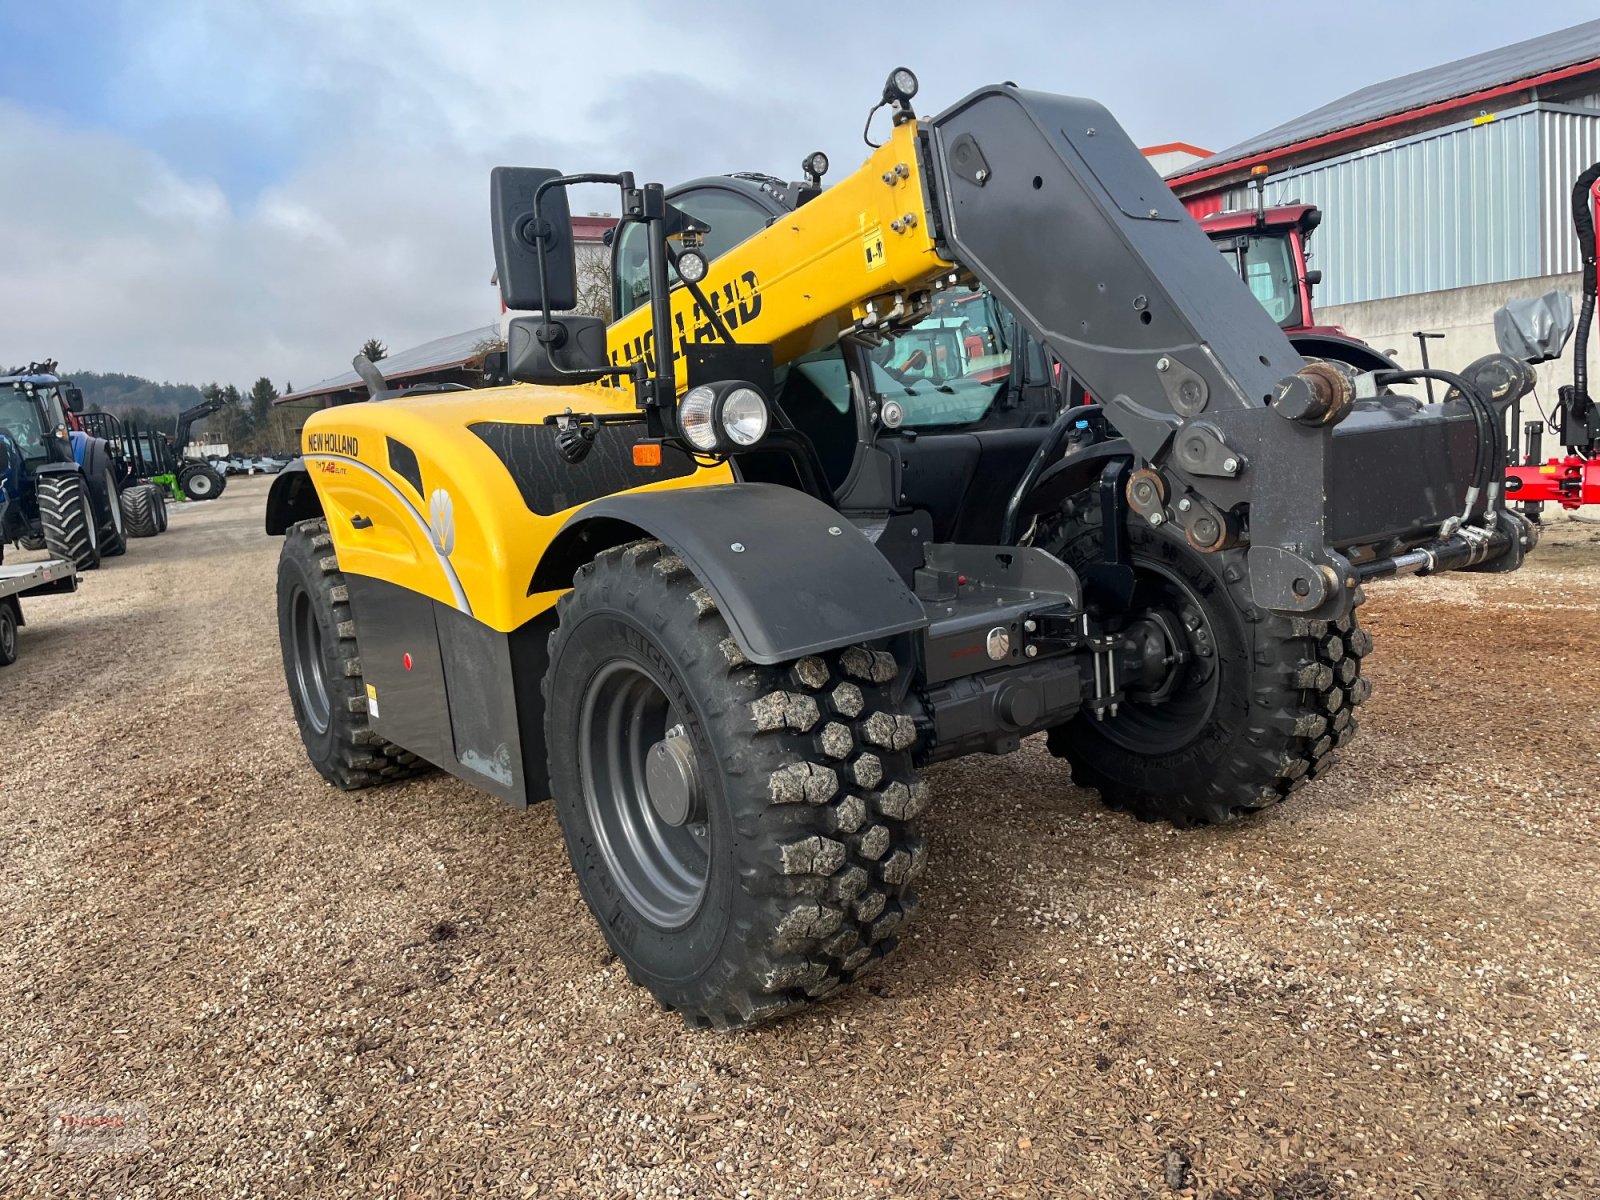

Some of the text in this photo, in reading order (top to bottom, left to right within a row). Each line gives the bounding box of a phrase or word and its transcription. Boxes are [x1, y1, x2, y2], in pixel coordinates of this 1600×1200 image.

[624, 270, 762, 384] HOLAND
[308, 433, 359, 457] NEW HOLLAND
